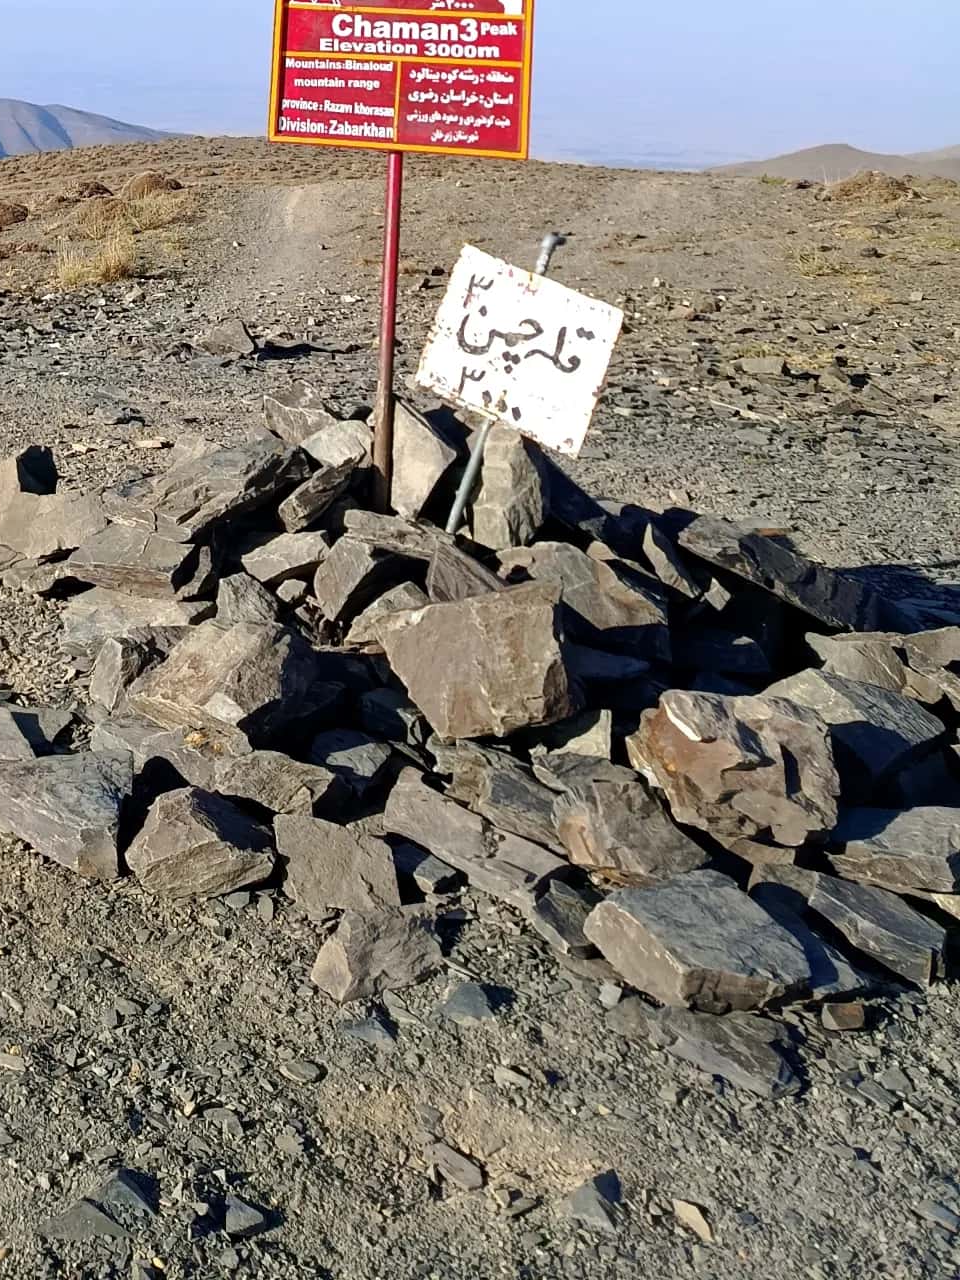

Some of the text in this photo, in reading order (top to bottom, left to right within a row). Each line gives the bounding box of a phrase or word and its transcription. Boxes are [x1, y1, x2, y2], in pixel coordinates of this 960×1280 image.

[480, 22, 517, 36] Peak
[319, 38, 500, 58] Elevation 3000m
[294, 77, 380, 90] mountain range
[408, 88, 438, 103] رضوی
[329, 120, 393, 138] Zabarkhan
[457, 305, 544, 374] چمن
[524, 326, 595, 373] قله
